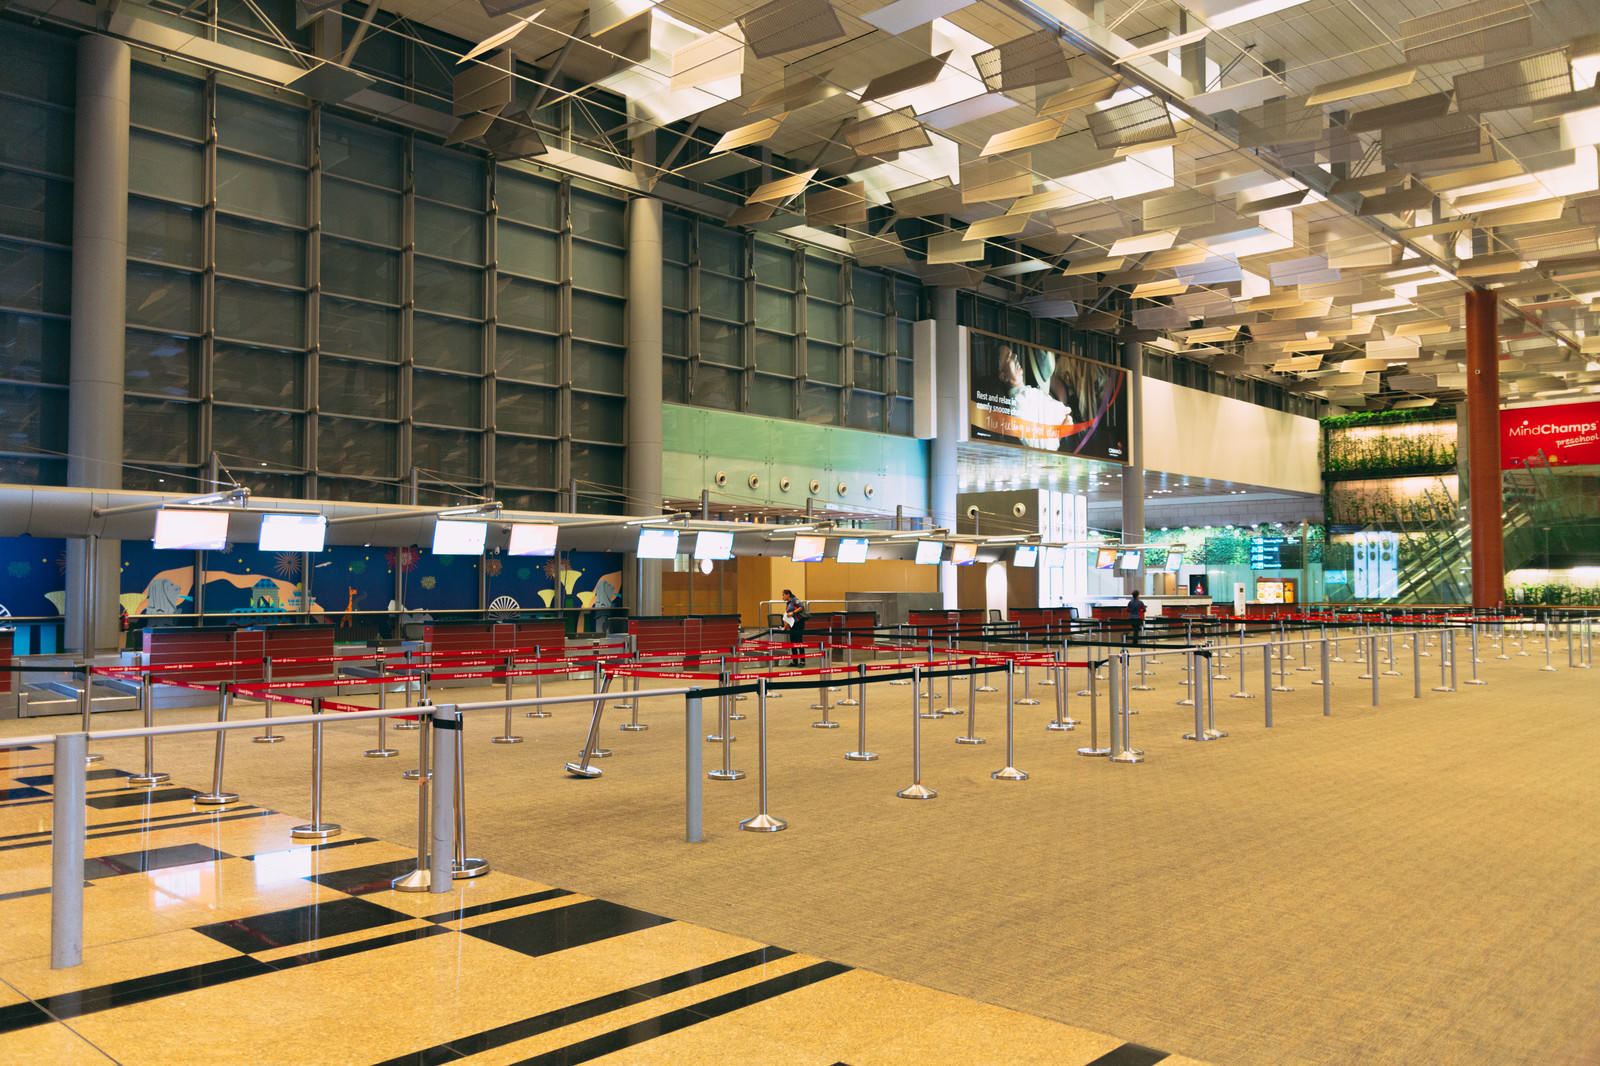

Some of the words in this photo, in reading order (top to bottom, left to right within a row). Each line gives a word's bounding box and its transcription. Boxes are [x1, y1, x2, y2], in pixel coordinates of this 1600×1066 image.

[977, 390, 988, 401] Rest
[989, 394, 998, 403] and
[999, 395, 1011, 406] relax
[1509, 420, 1597, 437] MindChamps
[1555, 433, 1600, 448] preschool
